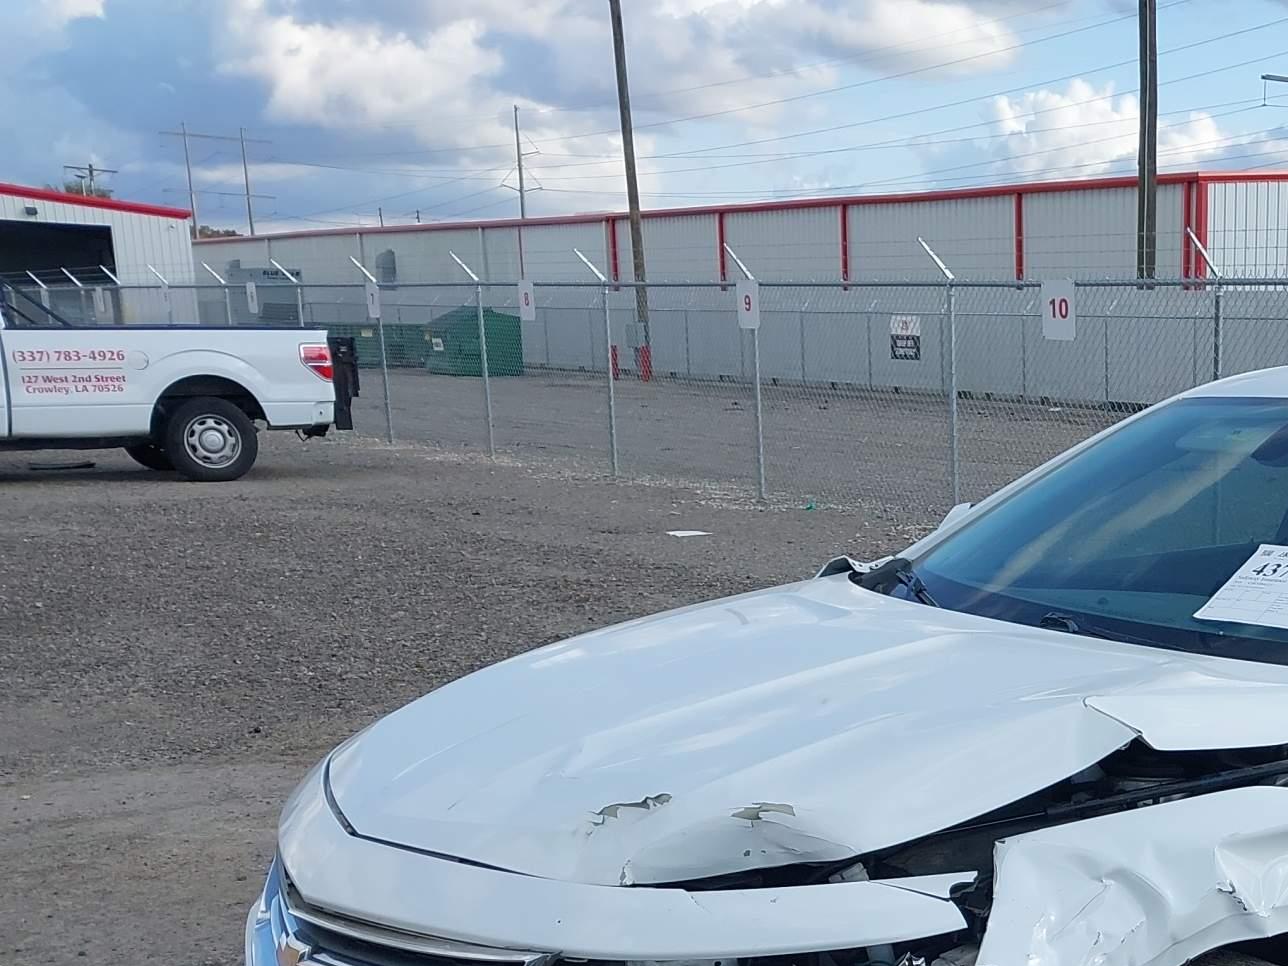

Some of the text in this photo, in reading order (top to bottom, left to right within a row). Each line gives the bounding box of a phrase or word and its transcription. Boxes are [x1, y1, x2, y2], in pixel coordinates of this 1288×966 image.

[744, 294, 751, 312] 9
[1049, 298, 1069, 319] 10
[12, 350, 125, 364] (337) 783-4926
[41, 375, 69, 384] West
[71, 374, 92, 383] 2nd
[94, 374, 126, 383] Street
[25, 384, 124, 395] Crowley, LA 70526
